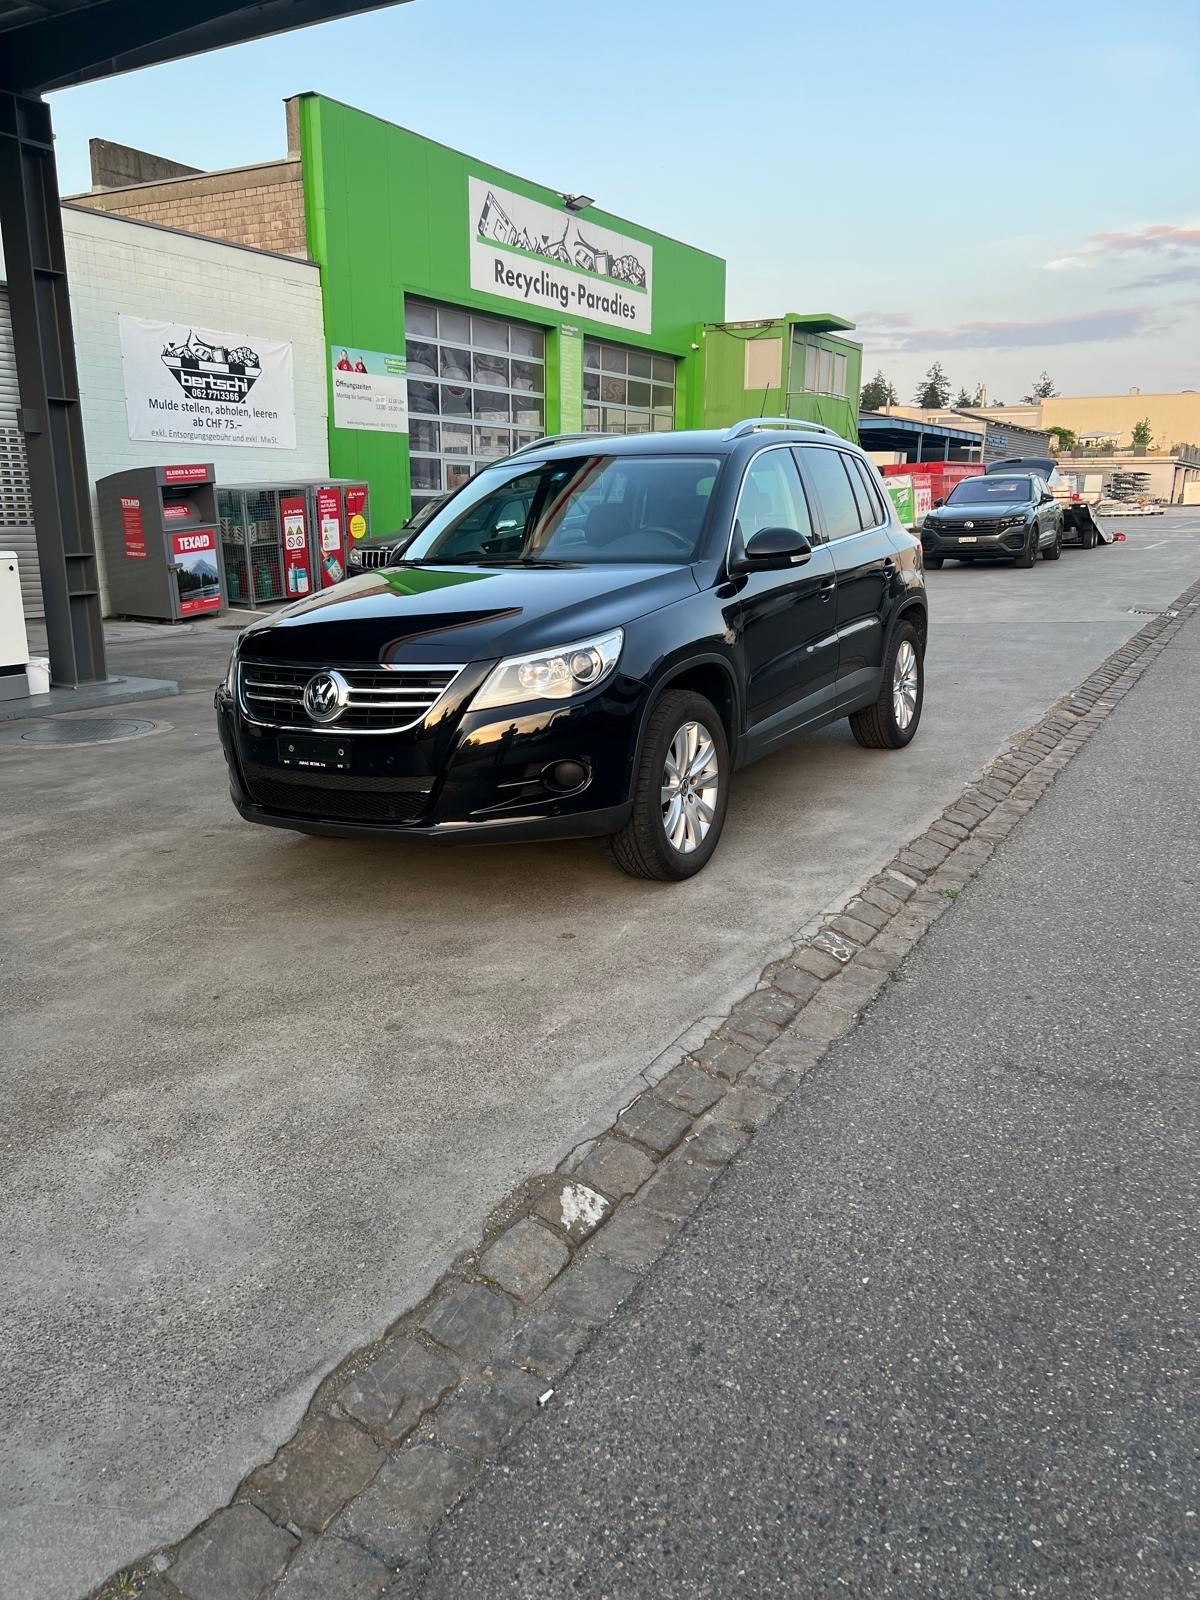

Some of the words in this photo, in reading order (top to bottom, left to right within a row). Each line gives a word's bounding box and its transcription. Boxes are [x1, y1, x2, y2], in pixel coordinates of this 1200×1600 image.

[494, 258, 636, 320] Recycling-Paradies
[180, 370, 248, 393] bertschi
[335, 378, 372, 391] Öffnungszeiten
[191, 388, 206, 398] 062
[208, 390, 240, 401] 7713366
[149, 398, 179, 411] Mulde
[181, 403, 213, 415] stellen,
[215, 405, 251, 418] abholen,
[253, 408, 278, 419] leeren
[192, 417, 204, 427] ab
[206, 418, 222, 428] CHF
[151, 429, 166, 437] exkl.
[169, 430, 231, 442] Entsorgungsgebühr
[233, 434, 244, 442] und
[246, 435, 258, 443] exkl.
[121, 499, 140, 507] TEXAID
[178, 535, 210, 551] TEXAID
